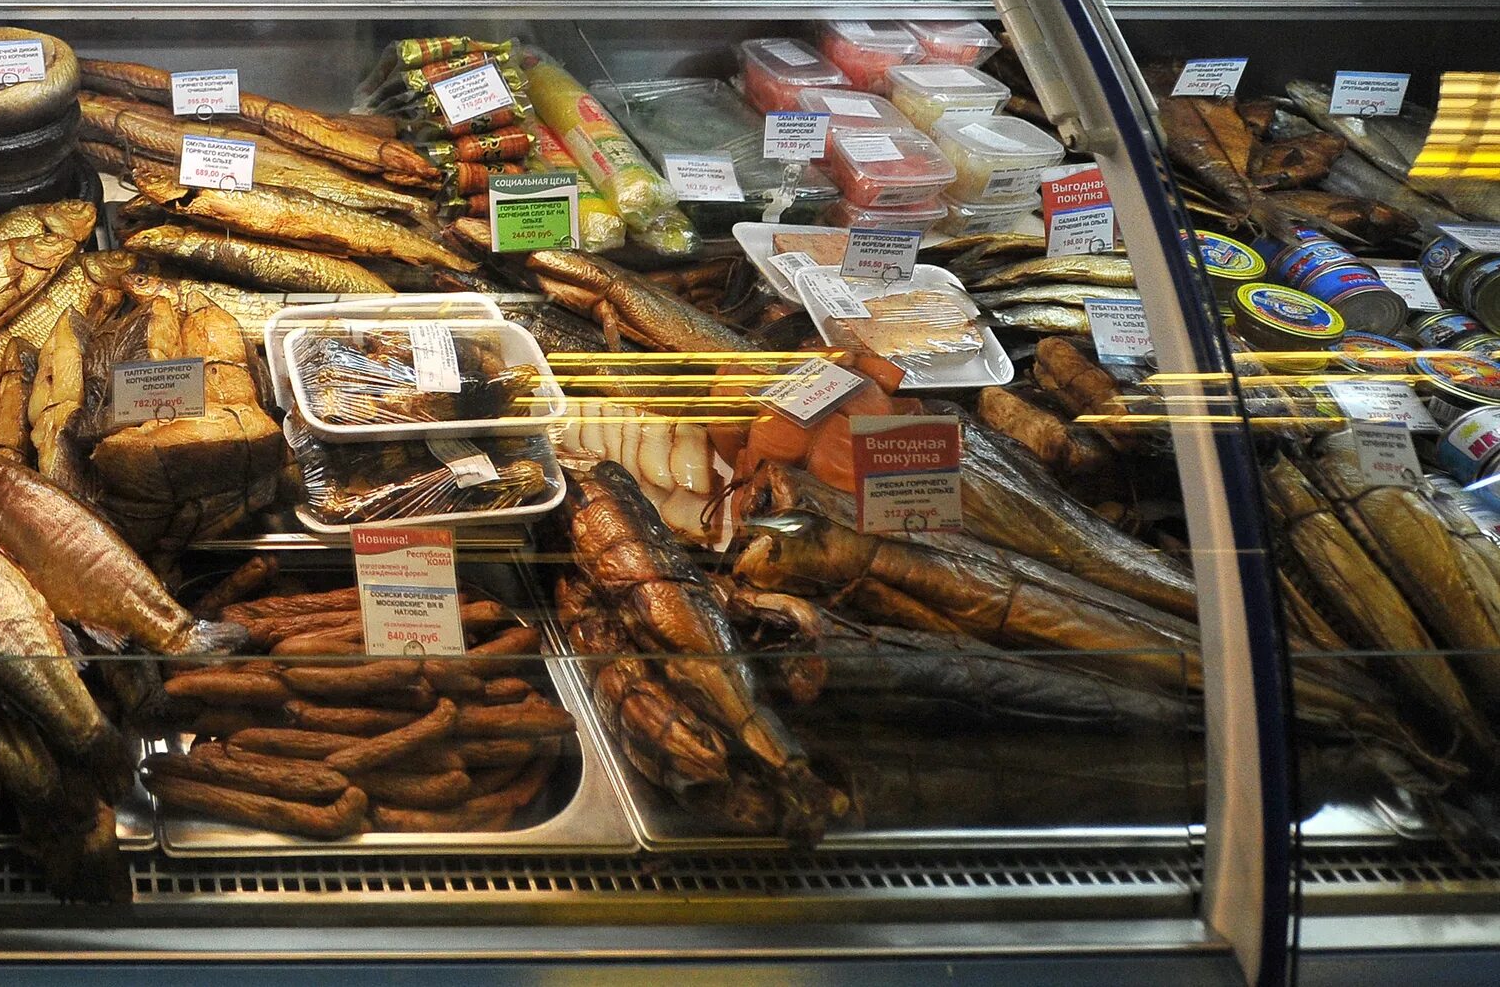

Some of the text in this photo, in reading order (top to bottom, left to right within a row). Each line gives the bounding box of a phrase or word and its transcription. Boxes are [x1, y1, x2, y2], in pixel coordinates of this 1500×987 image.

[495, 177, 571, 188] СОЦИАЛЬНАЯ ЦЕНА
[1052, 180, 1104, 193] Выгодная
[1058, 191, 1103, 204] покупка
[1079, 213, 1105, 221] ГОРЯЧЕГО
[538, 230, 553, 238] руб.
[124, 365, 192, 377] ПАЛТУС ГОРЯЧЕГО
[126, 375, 165, 384] КОПЧЕНИЯ
[165, 397, 184, 407] руб.
[866, 438, 946, 452] Выгодная
[873, 453, 940, 467] покупка
[906, 479, 948, 487] ГОРЯЧЕГО
[358, 534, 408, 544] Новинка!
[407, 550, 451, 560] Республика
